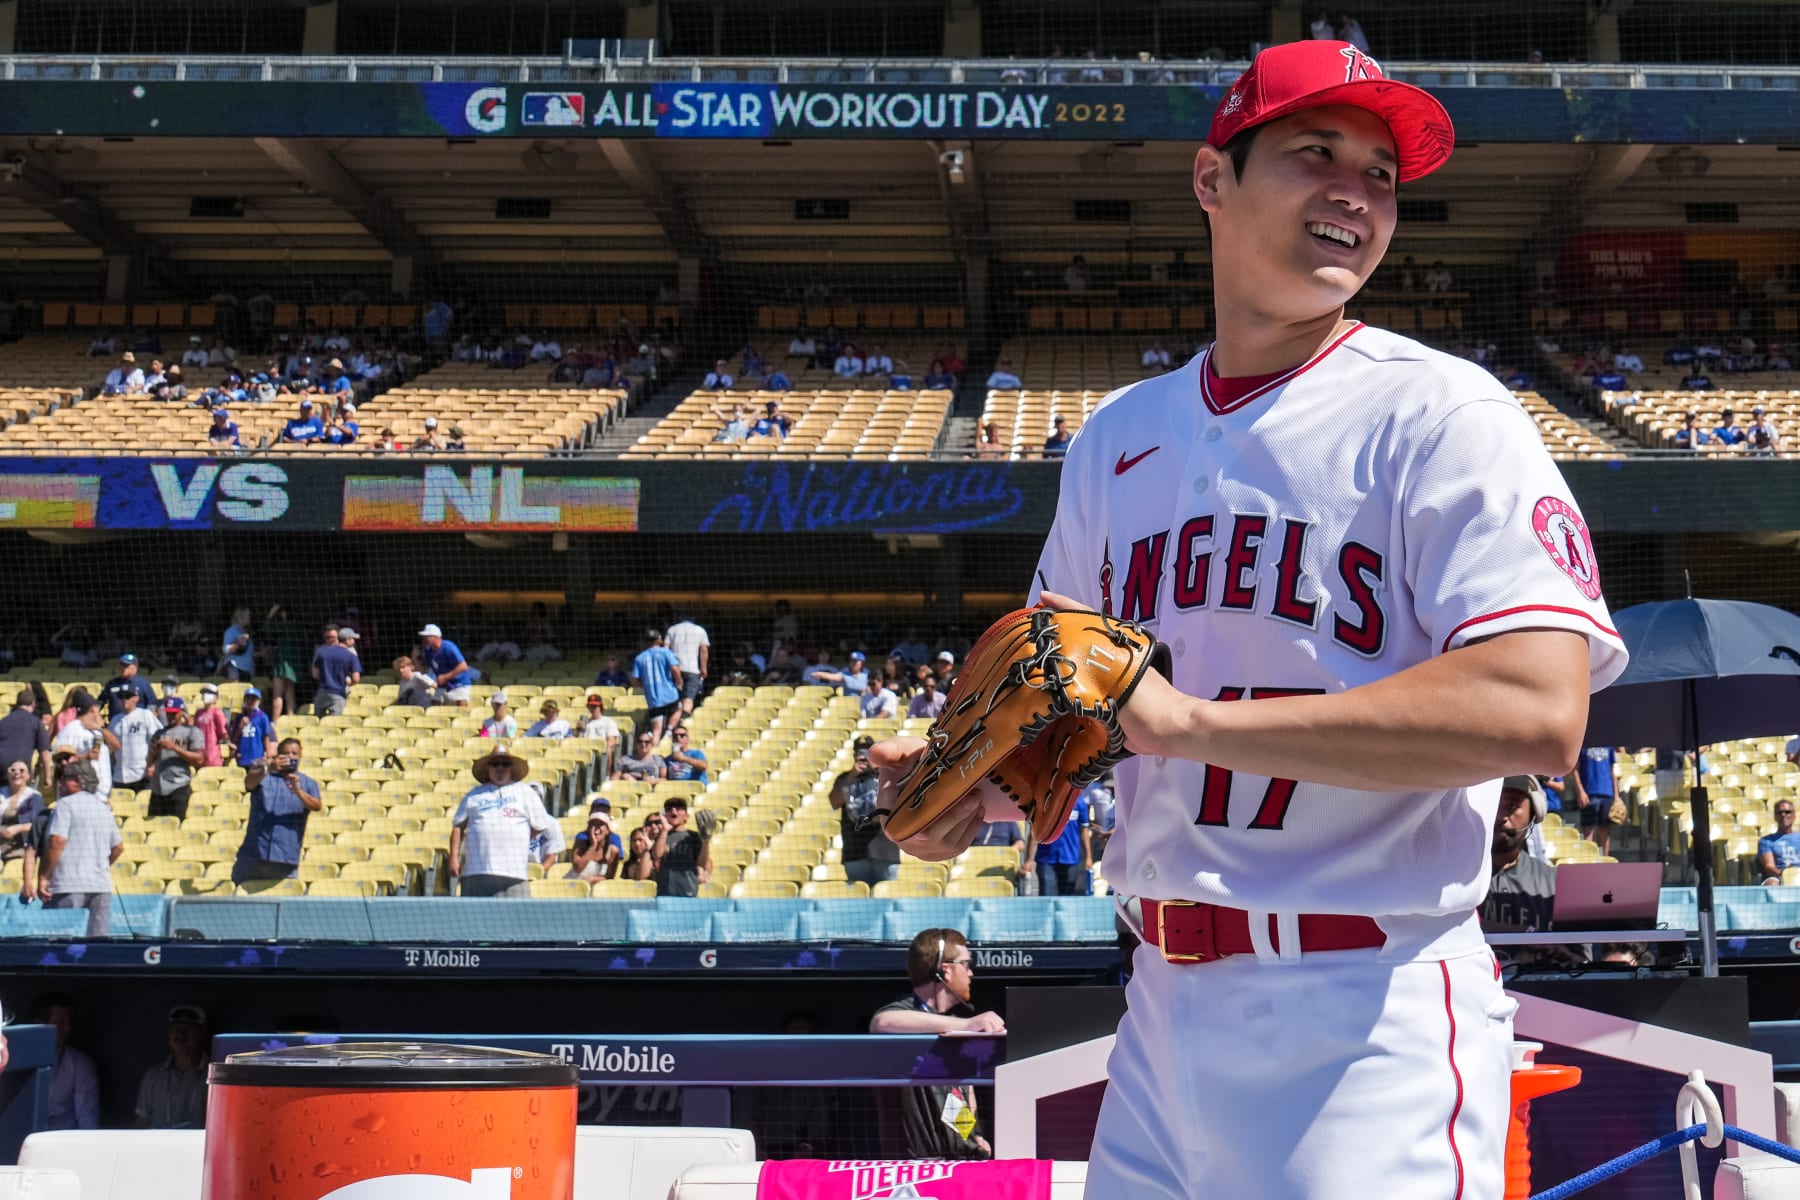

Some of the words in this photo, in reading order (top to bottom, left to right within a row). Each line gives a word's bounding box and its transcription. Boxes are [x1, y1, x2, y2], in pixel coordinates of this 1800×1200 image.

[465, 87, 506, 132] G
[769, 90, 968, 128] WORKOUT
[976, 91, 1049, 128] DAY
[1055, 103, 1126, 122] 2022
[150, 463, 289, 522] VS
[420, 465, 561, 523] NL
[1085, 644, 1115, 672] 17
[959, 739, 994, 779] i-Pro
[144, 946, 162, 965] G
[423, 950, 480, 967] Mobile
[699, 948, 717, 967] G
[976, 951, 1033, 967] Mobile
[579, 1044, 676, 1073] Mobile
[853, 1162, 954, 1200] DERBY
